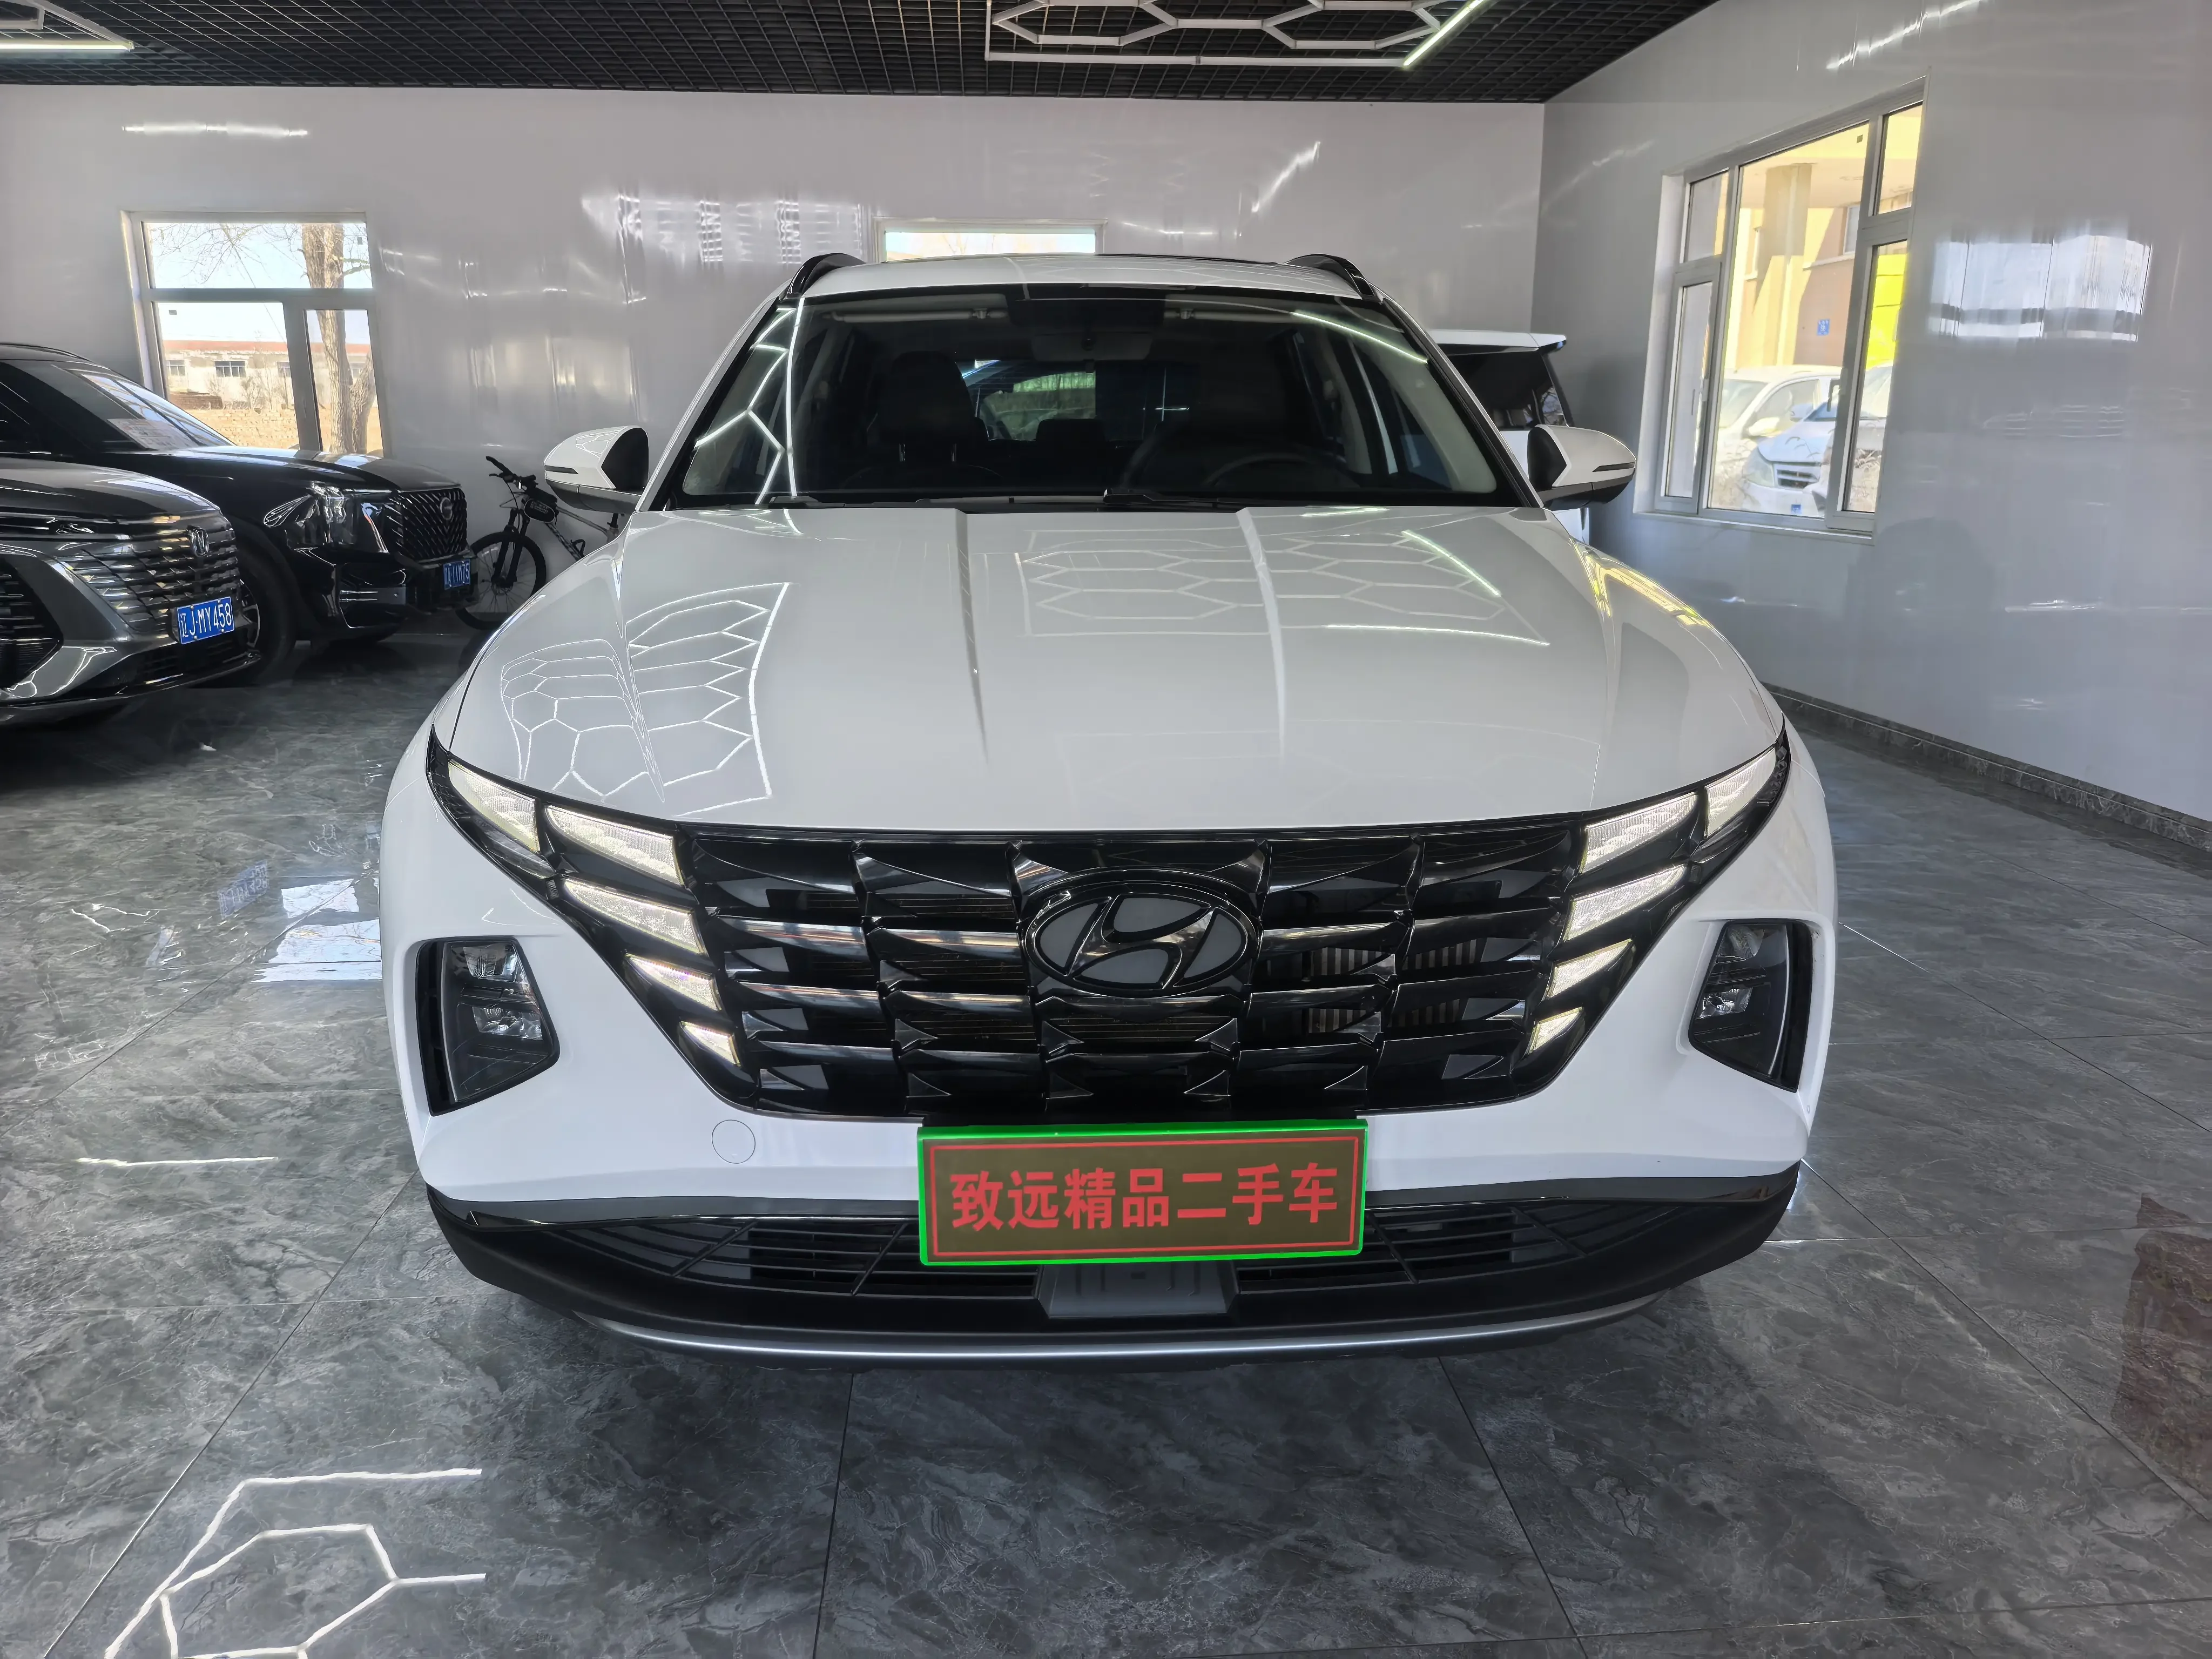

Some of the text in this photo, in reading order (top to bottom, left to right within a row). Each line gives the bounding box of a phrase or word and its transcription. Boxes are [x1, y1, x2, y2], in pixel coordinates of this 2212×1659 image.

[950, 1162, 1338, 1231] 致远精品二手车
